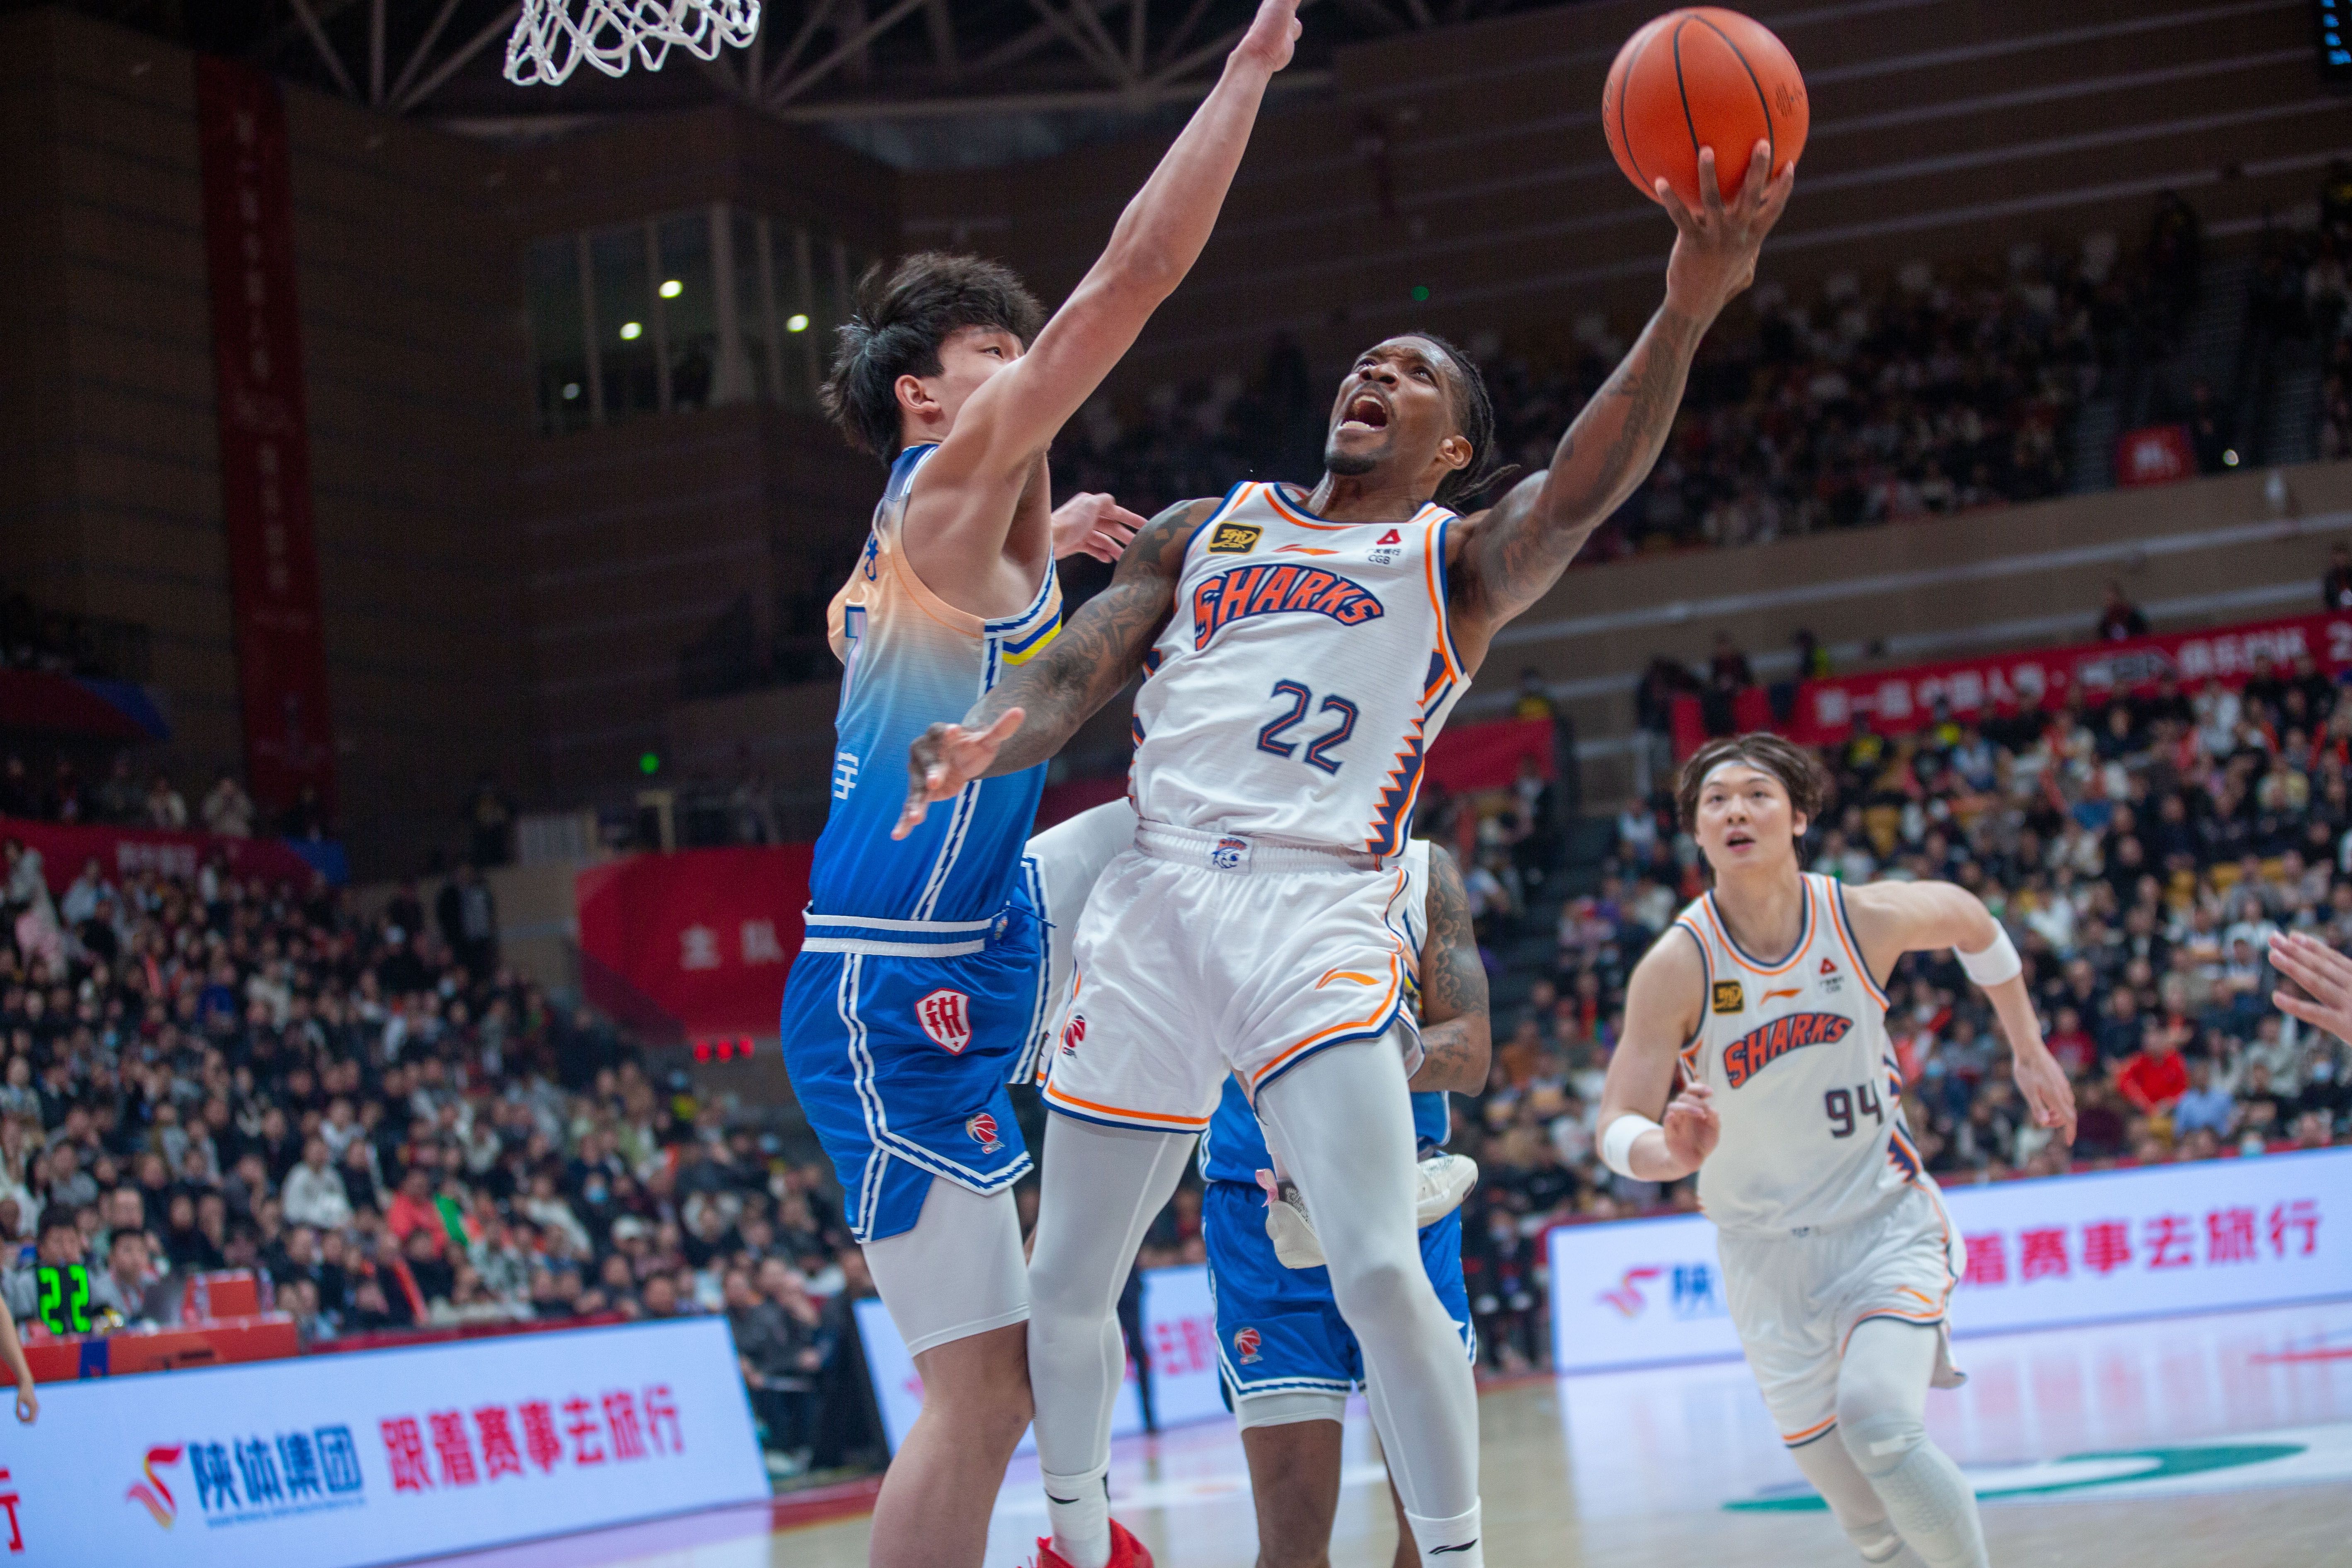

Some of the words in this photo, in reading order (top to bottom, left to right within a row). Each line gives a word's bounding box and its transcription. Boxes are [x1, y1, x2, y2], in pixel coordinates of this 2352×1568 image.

[1368, 555, 1390, 565] CGB
[1193, 563, 1385, 651] SHARKS
[1256, 679, 1360, 776] 22
[1723, 1012, 1853, 1089] SHARKS
[1824, 1078, 1885, 1138] 94
[39, 1264, 91, 1334] 22
[188, 1423, 362, 1510] 陕体集团
[380, 1385, 684, 1493] 跟着赛事去旅行
